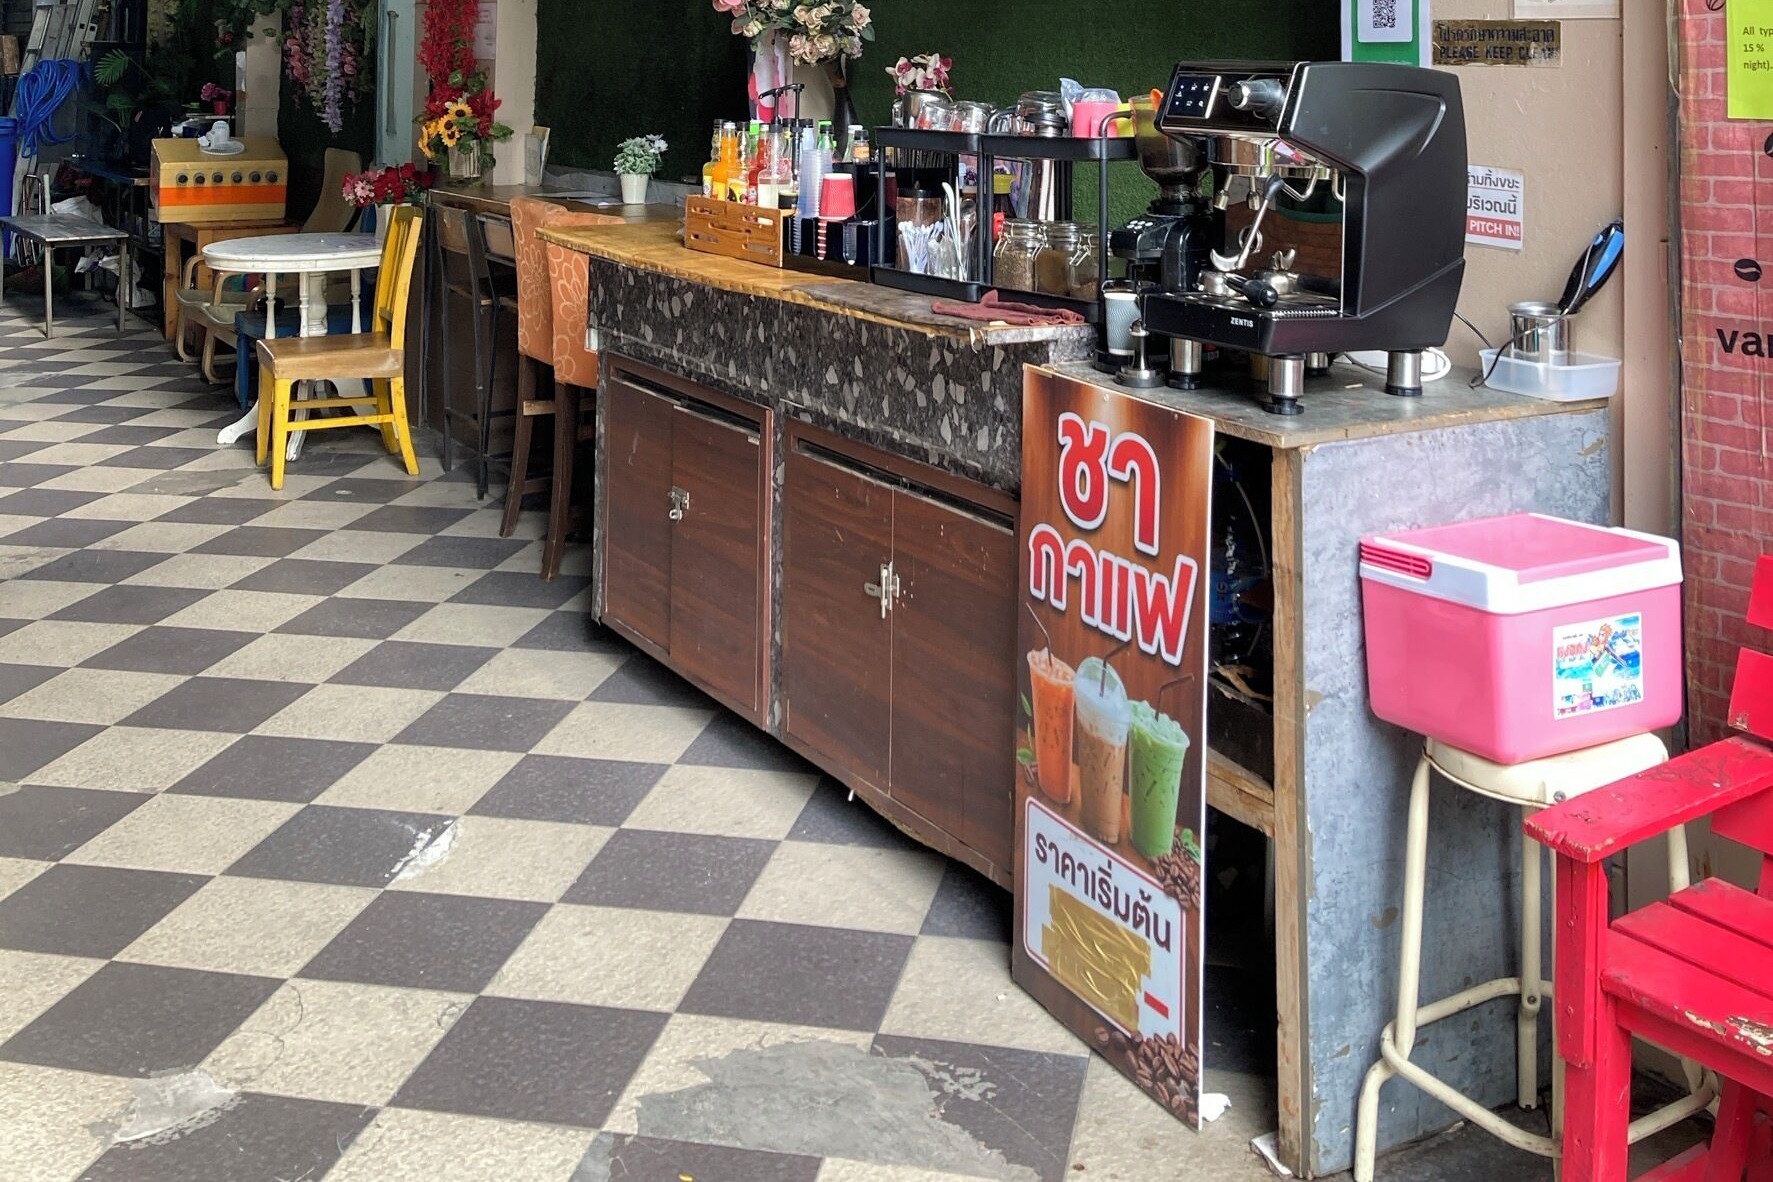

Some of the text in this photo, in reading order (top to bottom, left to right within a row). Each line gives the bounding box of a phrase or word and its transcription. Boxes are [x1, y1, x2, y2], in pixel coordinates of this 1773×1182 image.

[1743, 26, 1755, 36] All
[1440, 46, 1479, 59] PLEASE
[1485, 46, 1513, 59] KEEP
[1744, 44, 1765, 53] 15 %
[1470, 220, 1520, 237] PITCH IN!
[1230, 316, 1254, 328] ZENTIS
[1057, 411, 1160, 557] ชา
[1029, 523, 1198, 666] กาแฟ
[1035, 830, 1171, 952] ราคาเริ่มต้น
